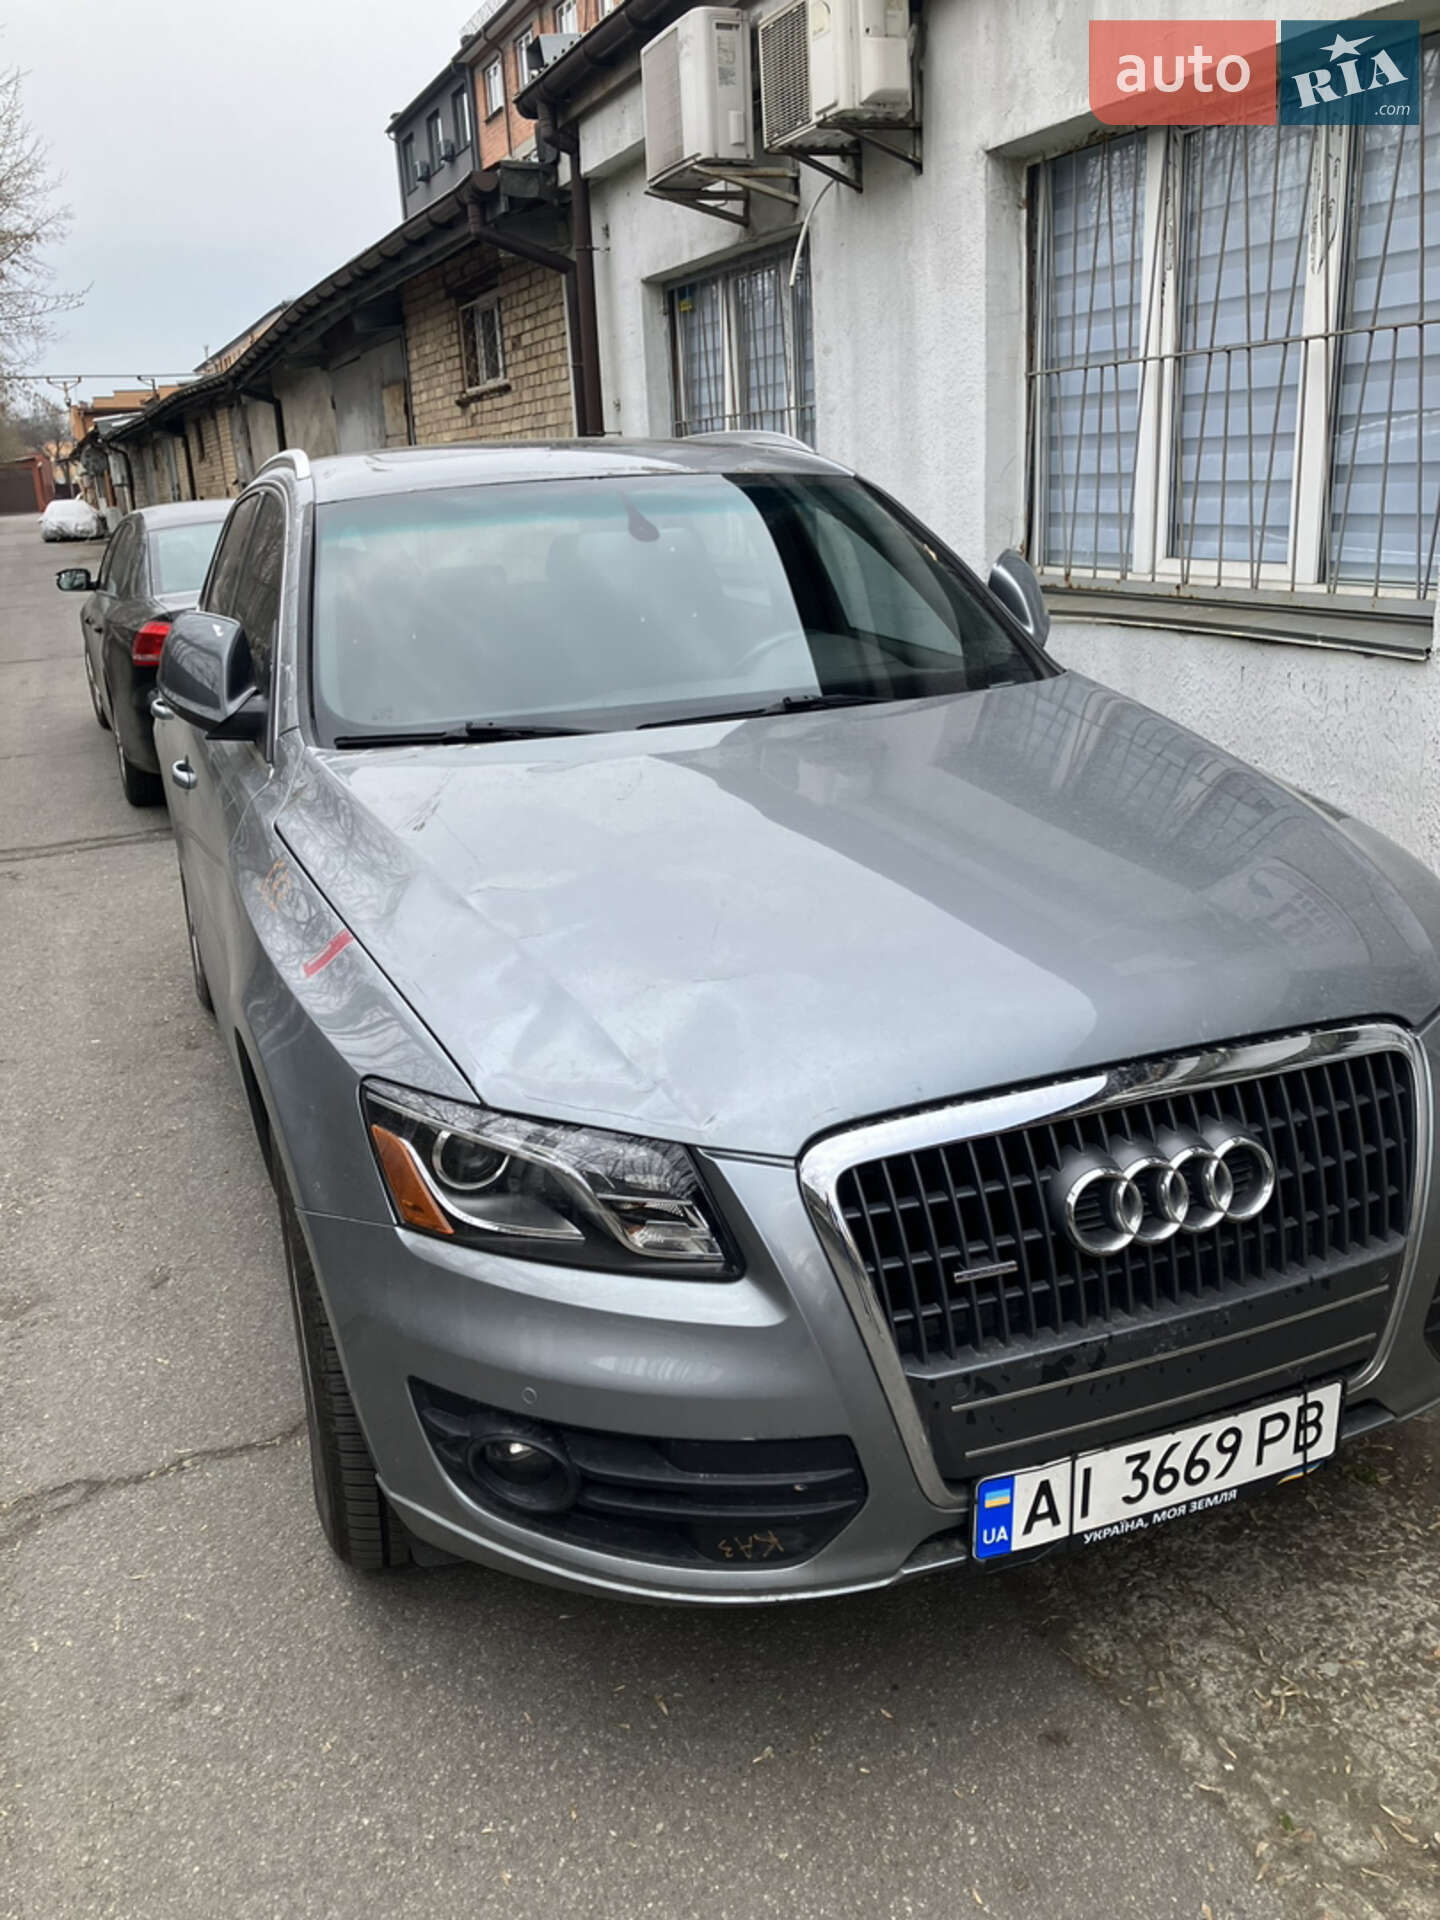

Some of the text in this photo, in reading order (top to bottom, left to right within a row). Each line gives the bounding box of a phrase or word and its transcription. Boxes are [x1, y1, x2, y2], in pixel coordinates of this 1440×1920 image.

[1121, 1426, 1243, 1505] 3669
[983, 1528, 1008, 1545] UA
[1083, 1489, 1238, 1544] УКРАЇНА, МОЯ ЗЕМЛЯ
